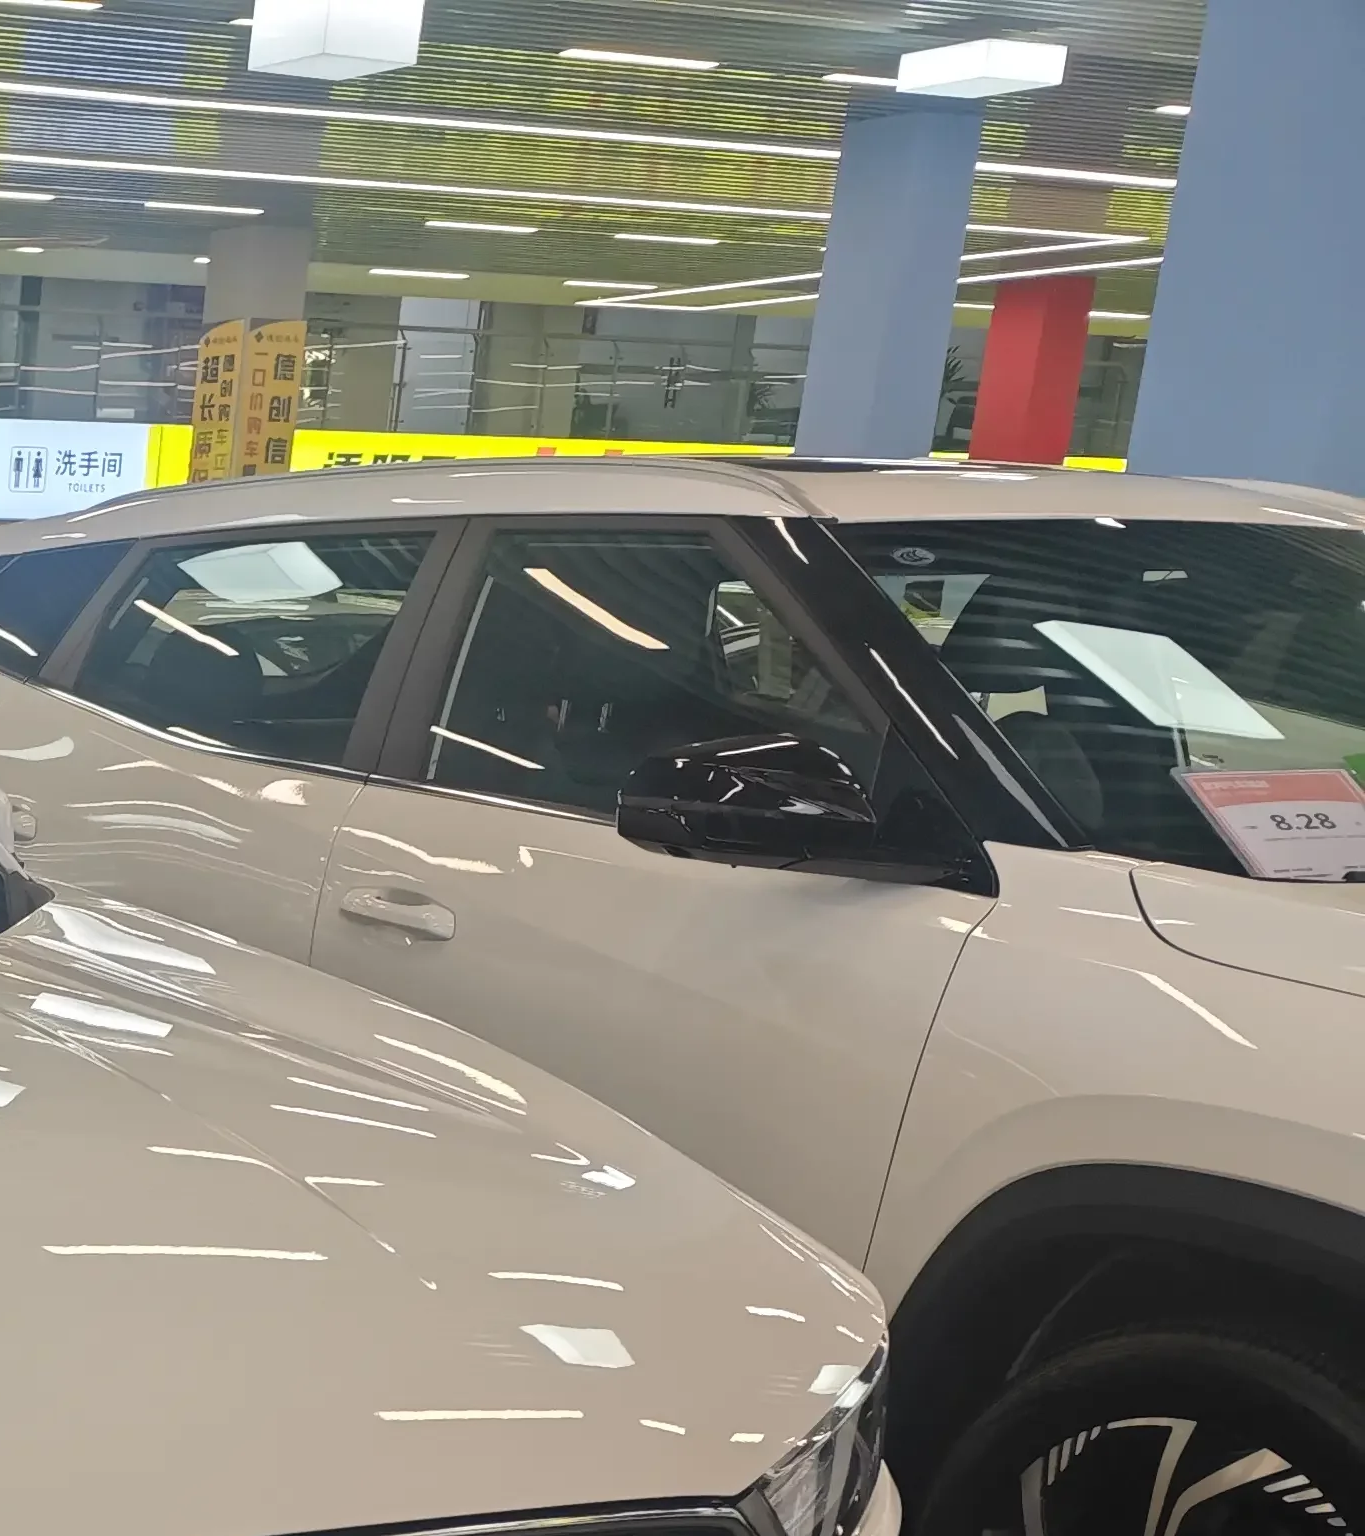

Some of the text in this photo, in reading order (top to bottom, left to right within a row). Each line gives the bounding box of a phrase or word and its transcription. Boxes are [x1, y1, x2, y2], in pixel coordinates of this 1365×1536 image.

[55, 449, 123, 478] 洗手间
[67, 482, 106, 494] TOILETS
[1270, 812, 1337, 831] 8.28
